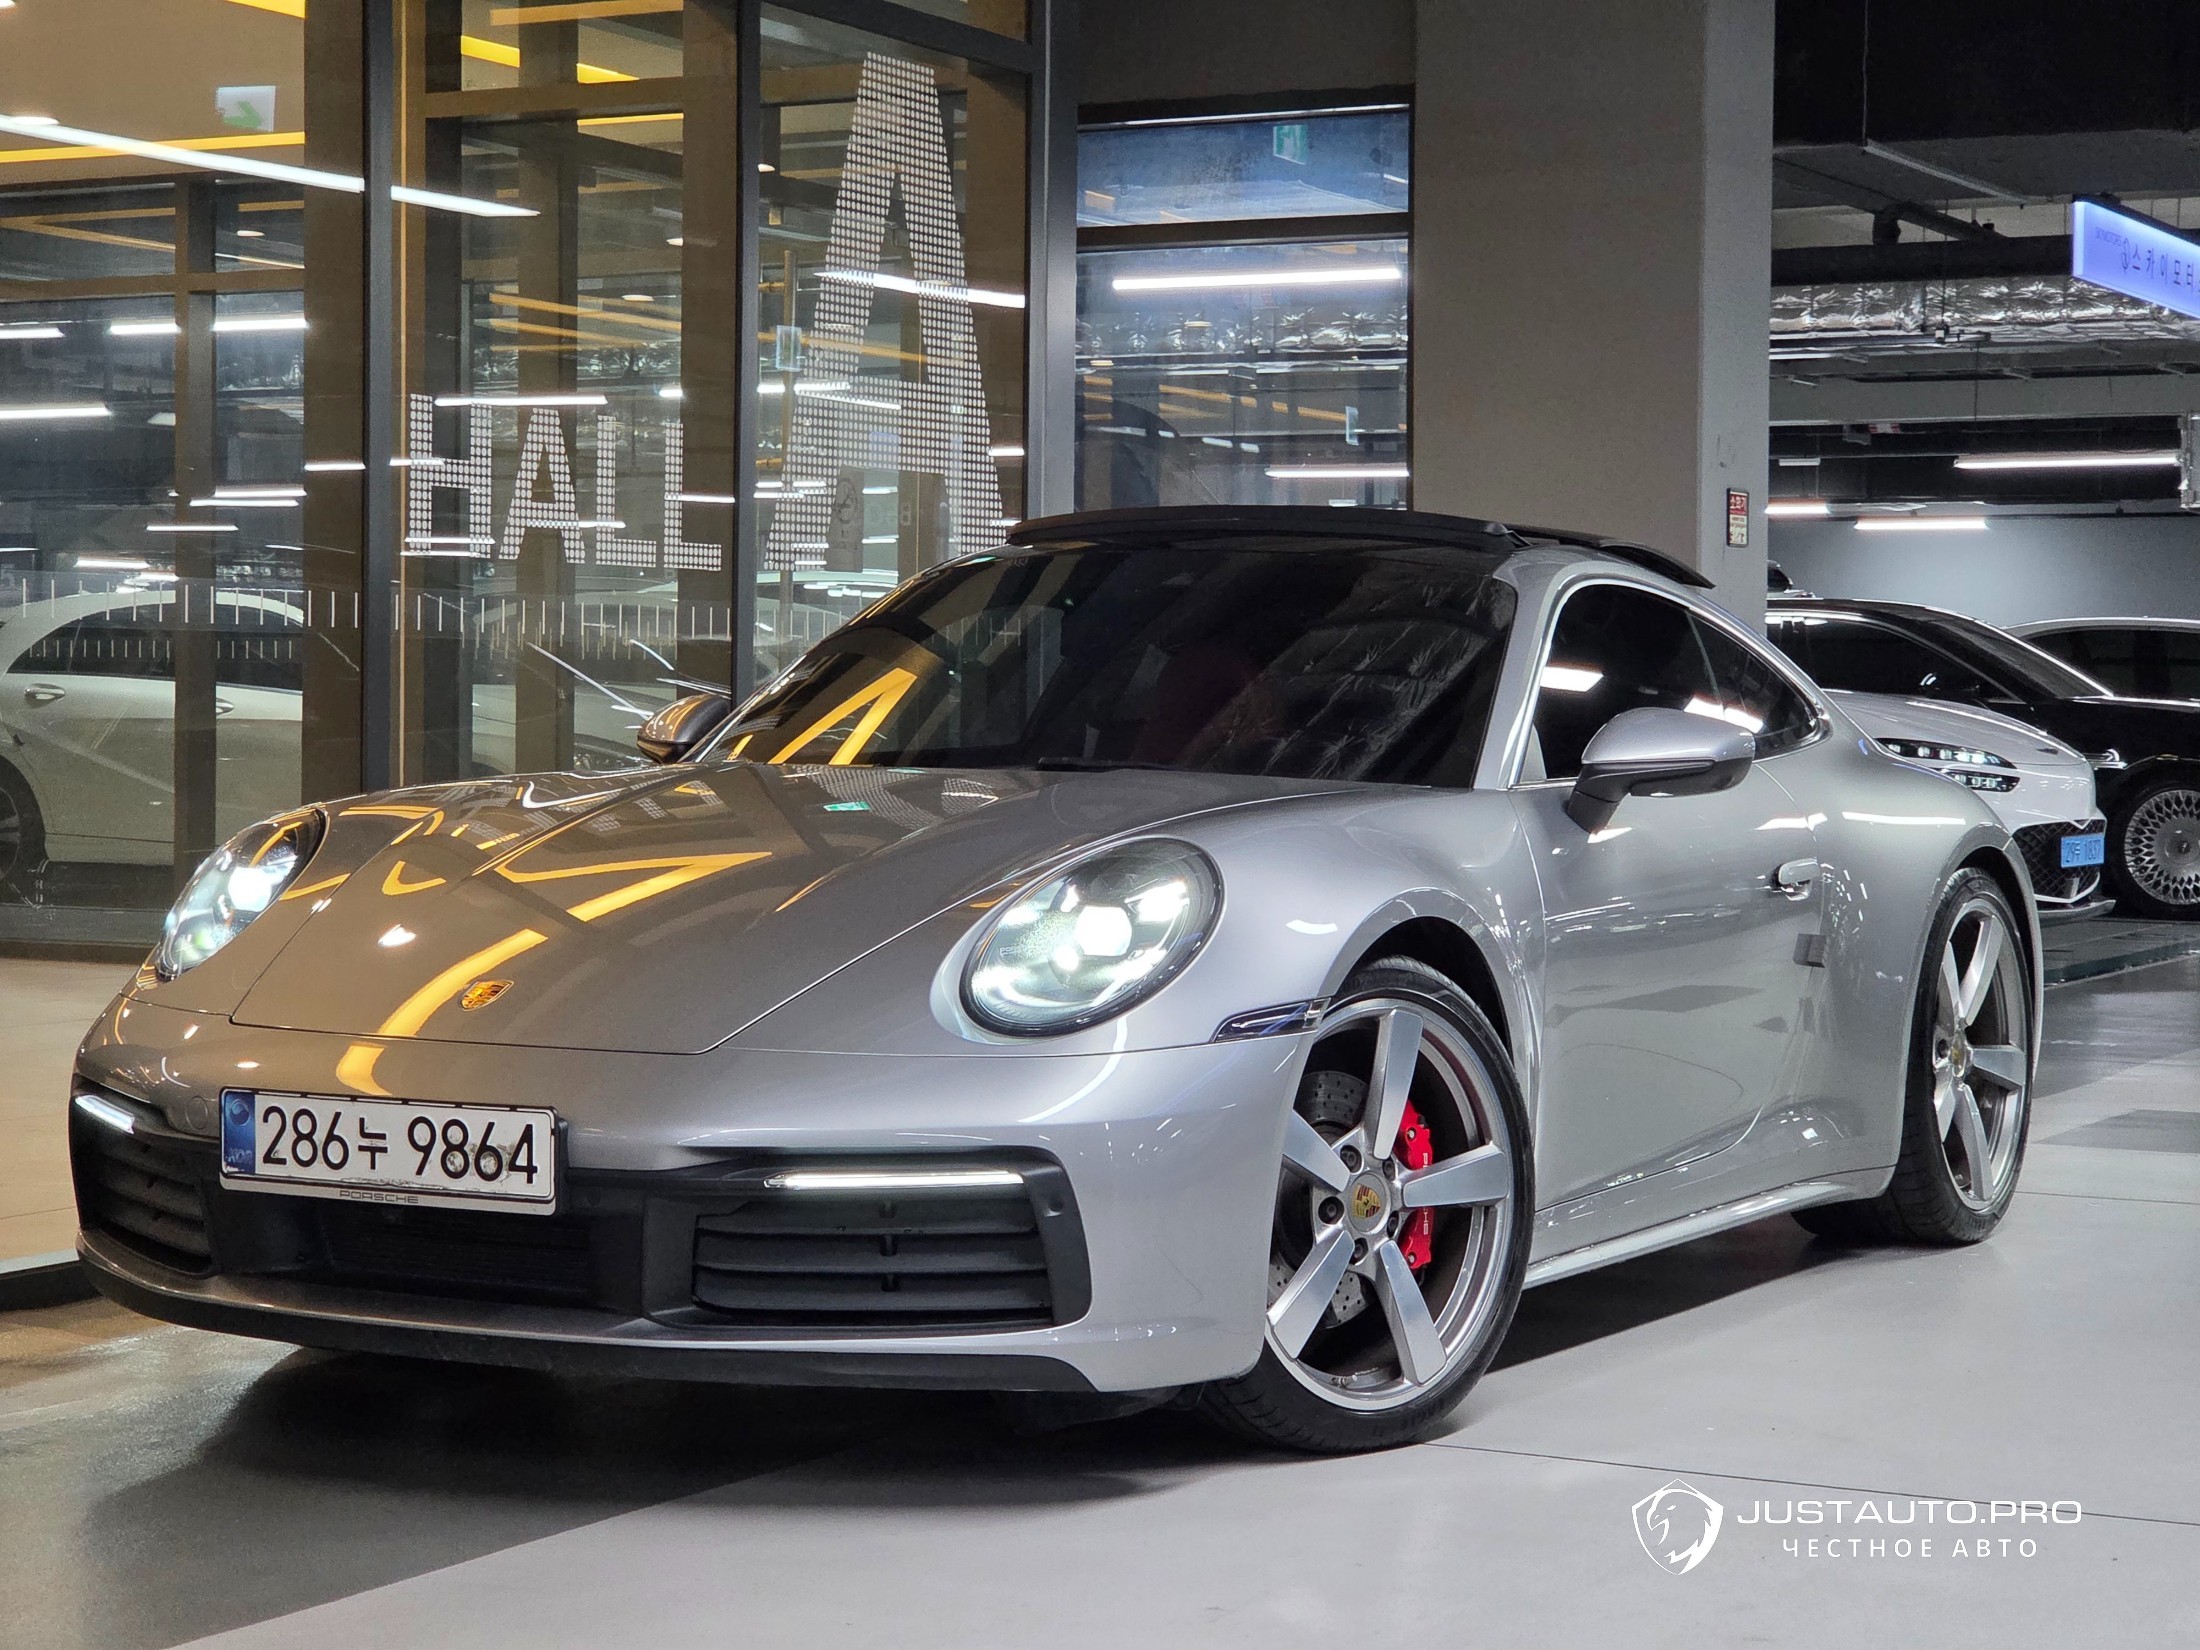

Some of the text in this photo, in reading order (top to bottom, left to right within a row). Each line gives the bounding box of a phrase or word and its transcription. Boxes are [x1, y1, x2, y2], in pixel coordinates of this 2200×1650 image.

[2132, 243, 2200, 294] 스카이모터
[405, 52, 1007, 572] HALL A
[262, 1105, 538, 1184] 286누 9864
[339, 1189, 419, 1204] PORSCHE
